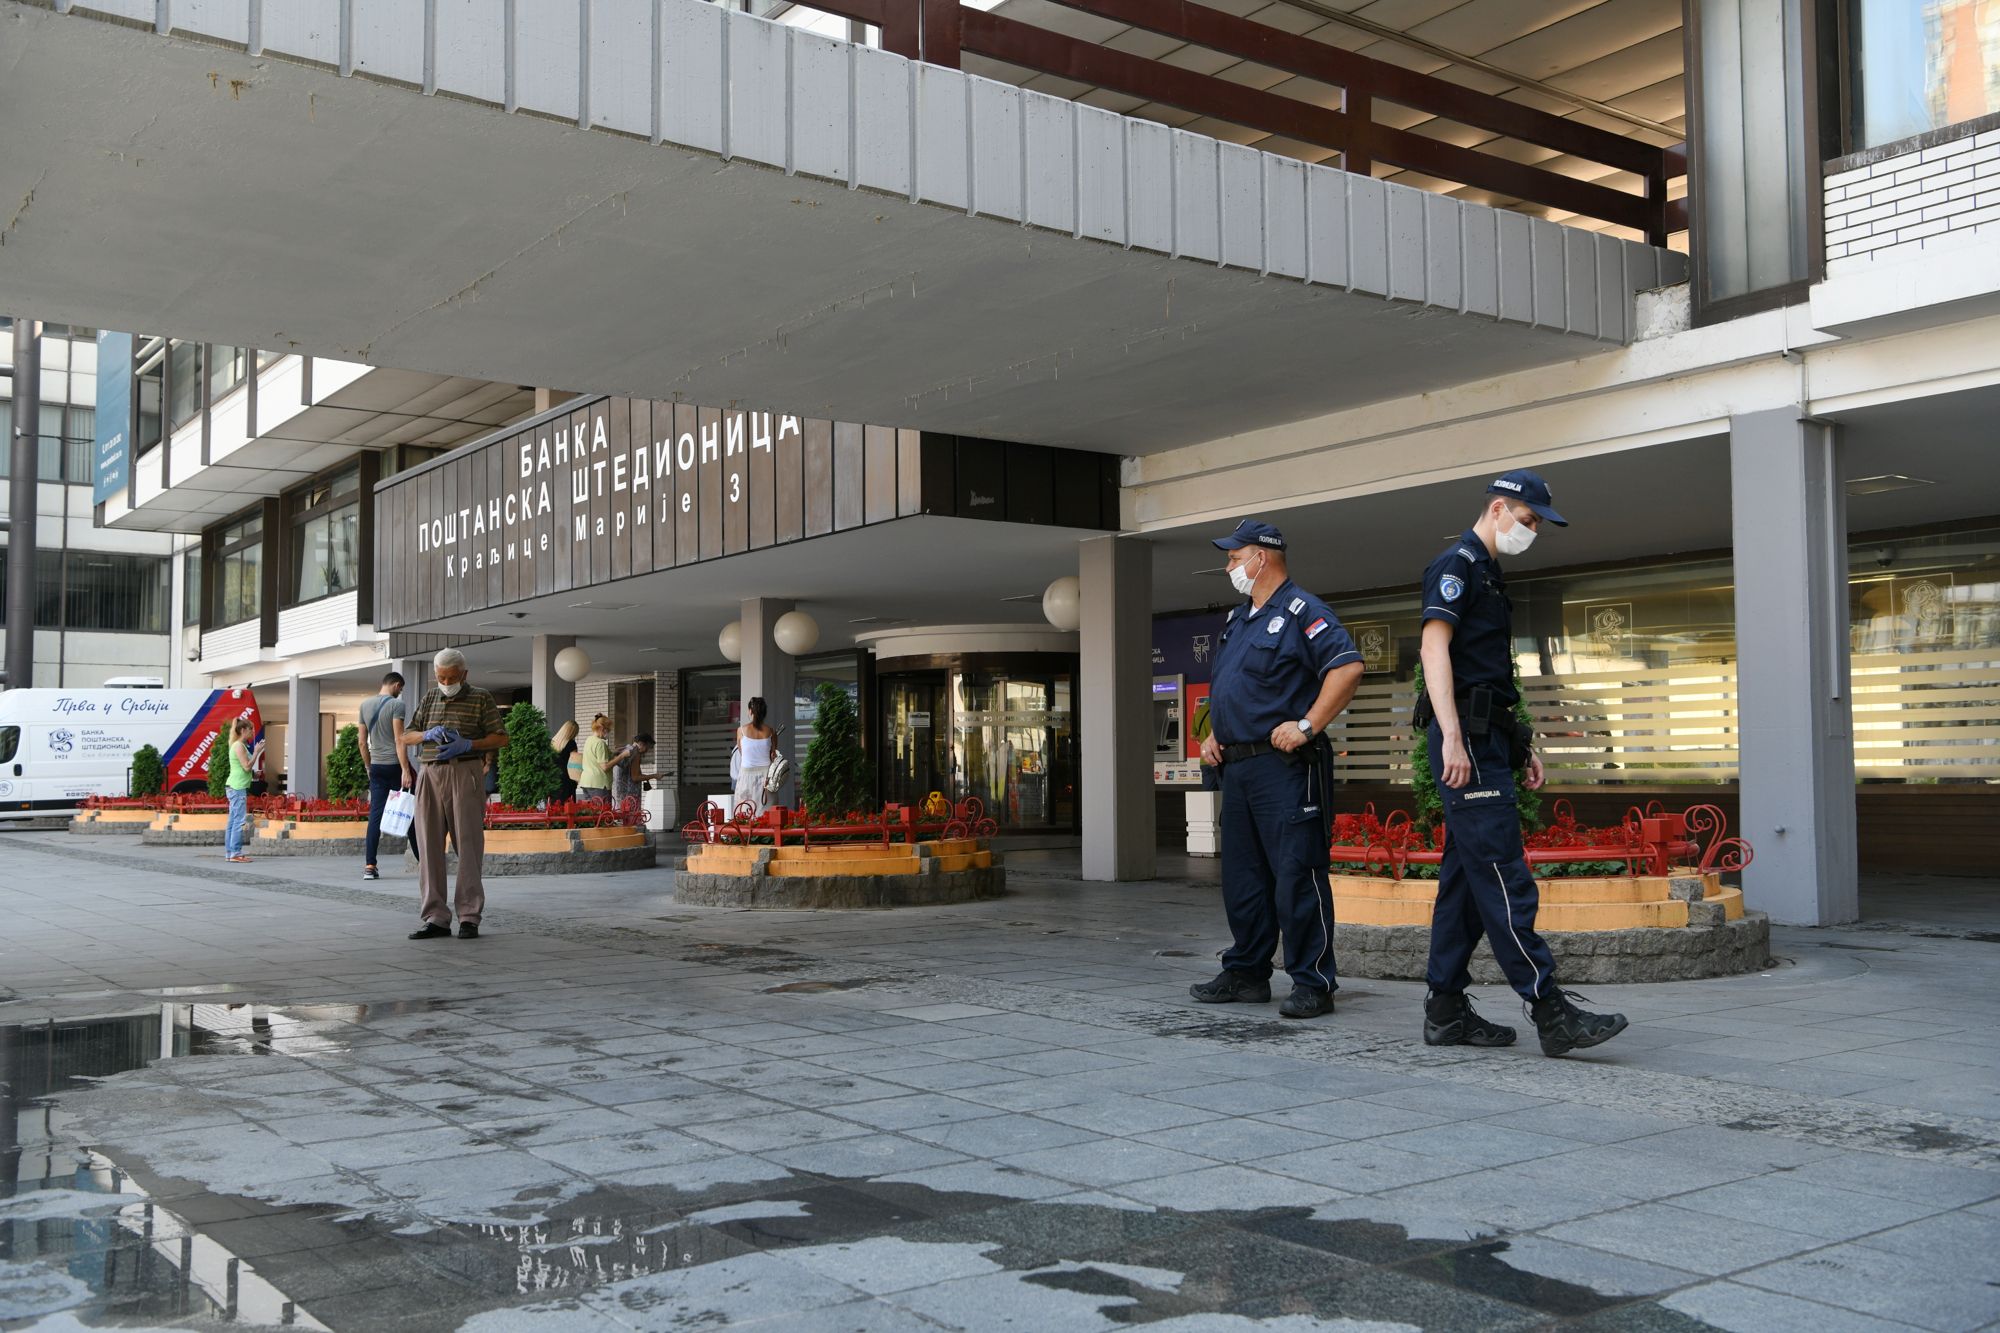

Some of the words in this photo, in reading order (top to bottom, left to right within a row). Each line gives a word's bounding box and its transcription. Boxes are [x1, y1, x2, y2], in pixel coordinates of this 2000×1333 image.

[521, 416, 607, 478] БАНКА
[419, 481, 551, 552] ПОШТАНСКА
[573, 411, 800, 504] ШТЕДИОНИЦА
[447, 533, 548, 578] Краљице
[575, 492, 691, 542] Марије
[730, 473, 740, 503] 3
[52, 698, 96, 716] Прва
[103, 703, 113, 715] у
[121, 697, 169, 715] Србији
[177, 730, 218, 778] МОБИЛНА
[1464, 790, 1501, 800] ПОЛИЦИЈА
